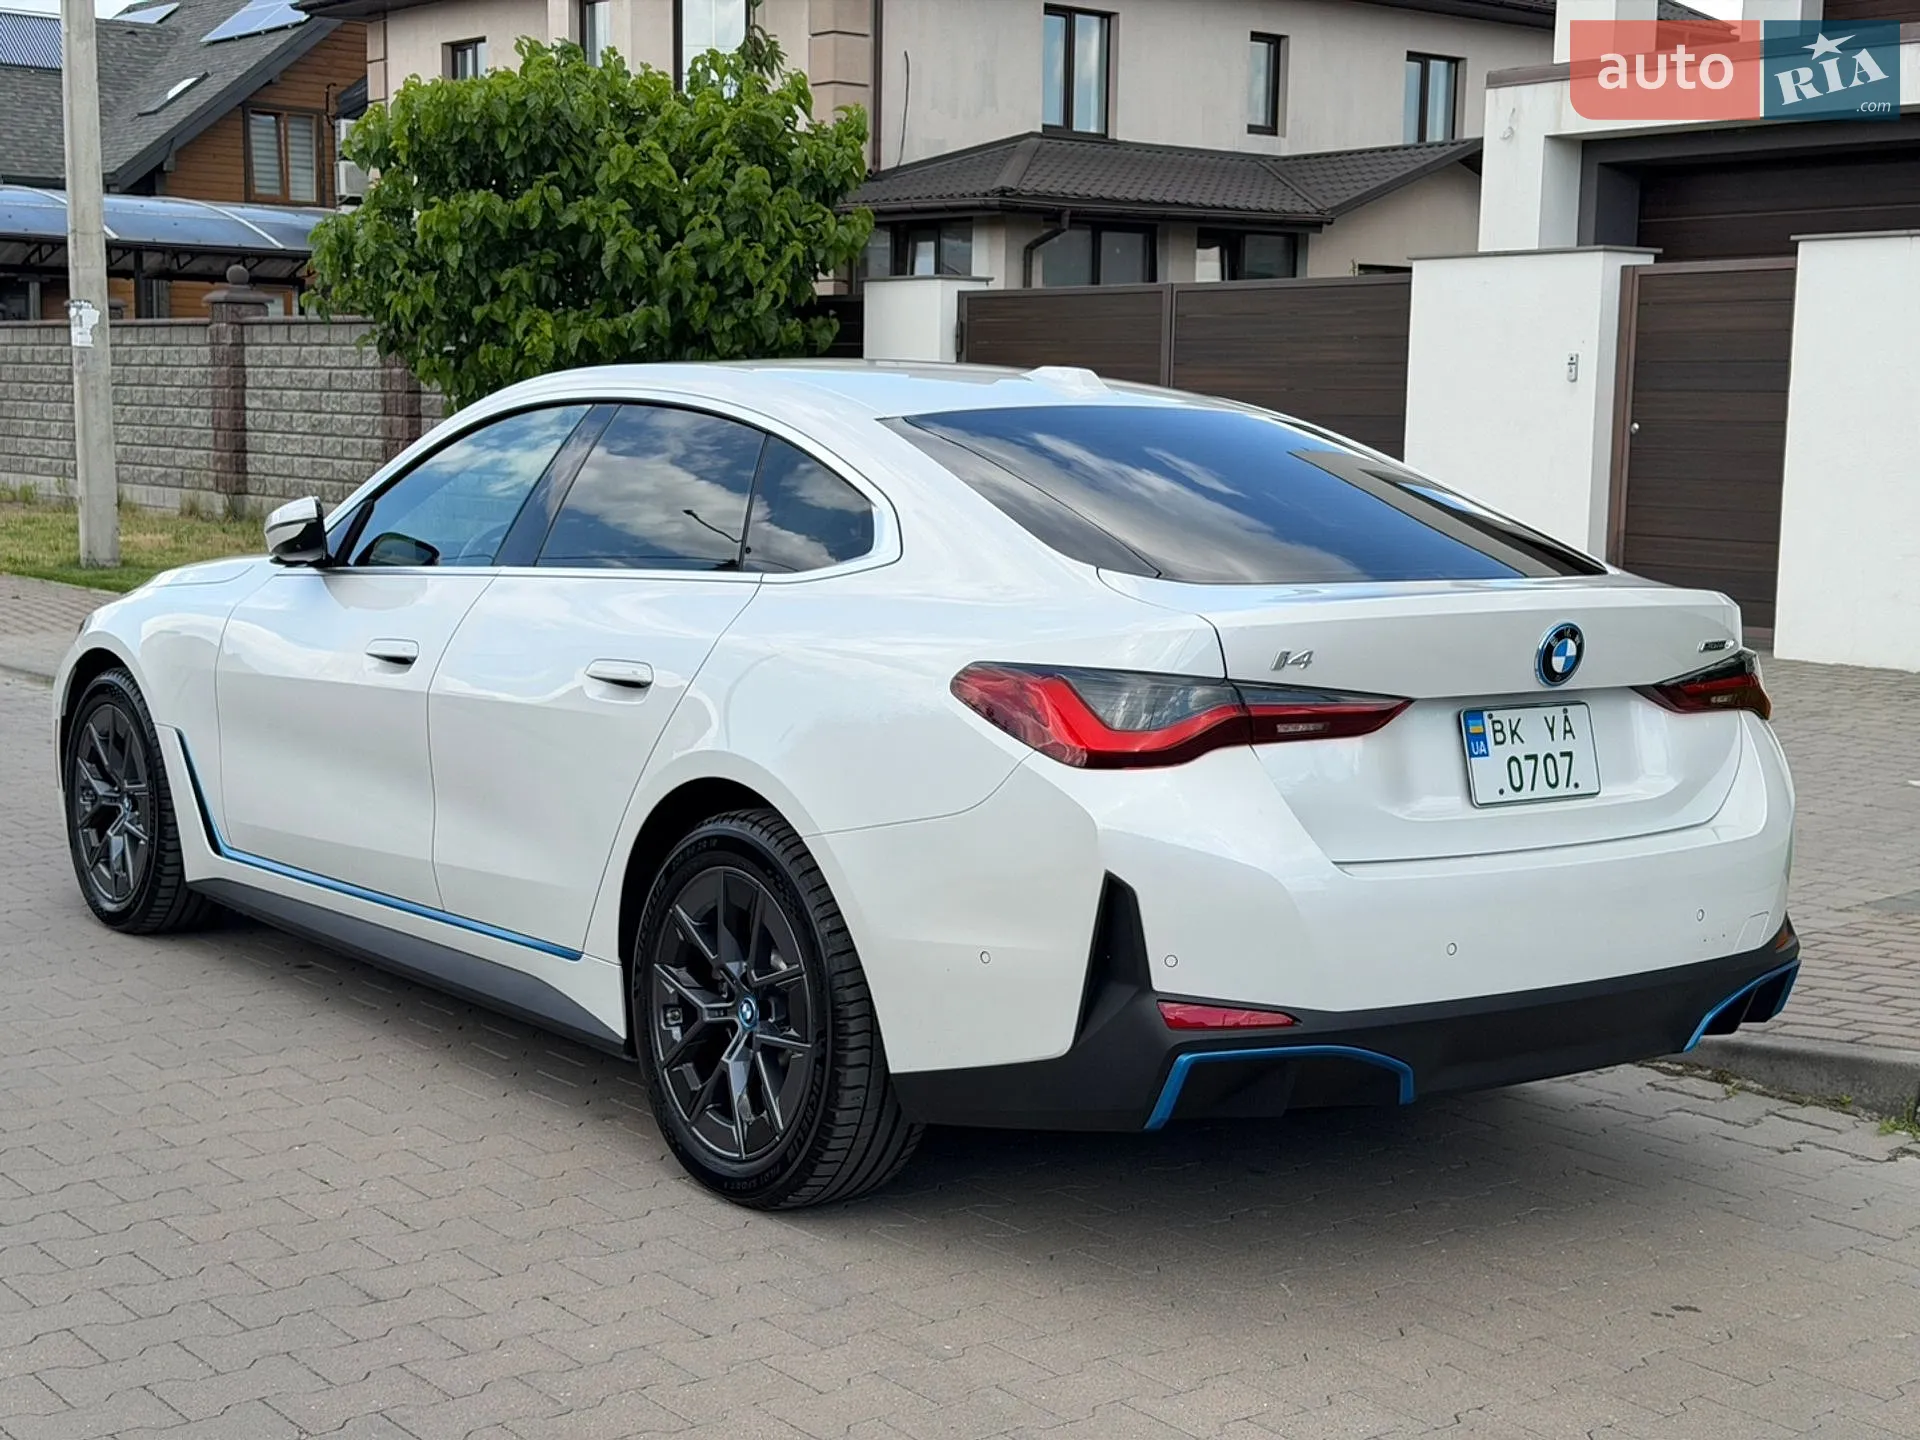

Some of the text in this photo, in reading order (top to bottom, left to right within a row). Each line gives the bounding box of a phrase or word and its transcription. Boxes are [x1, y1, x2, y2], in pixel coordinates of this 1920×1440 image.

[1491, 714, 1576, 746] BK YA
[1470, 741, 1488, 755] UA
[1507, 751, 1573, 793] 0707
